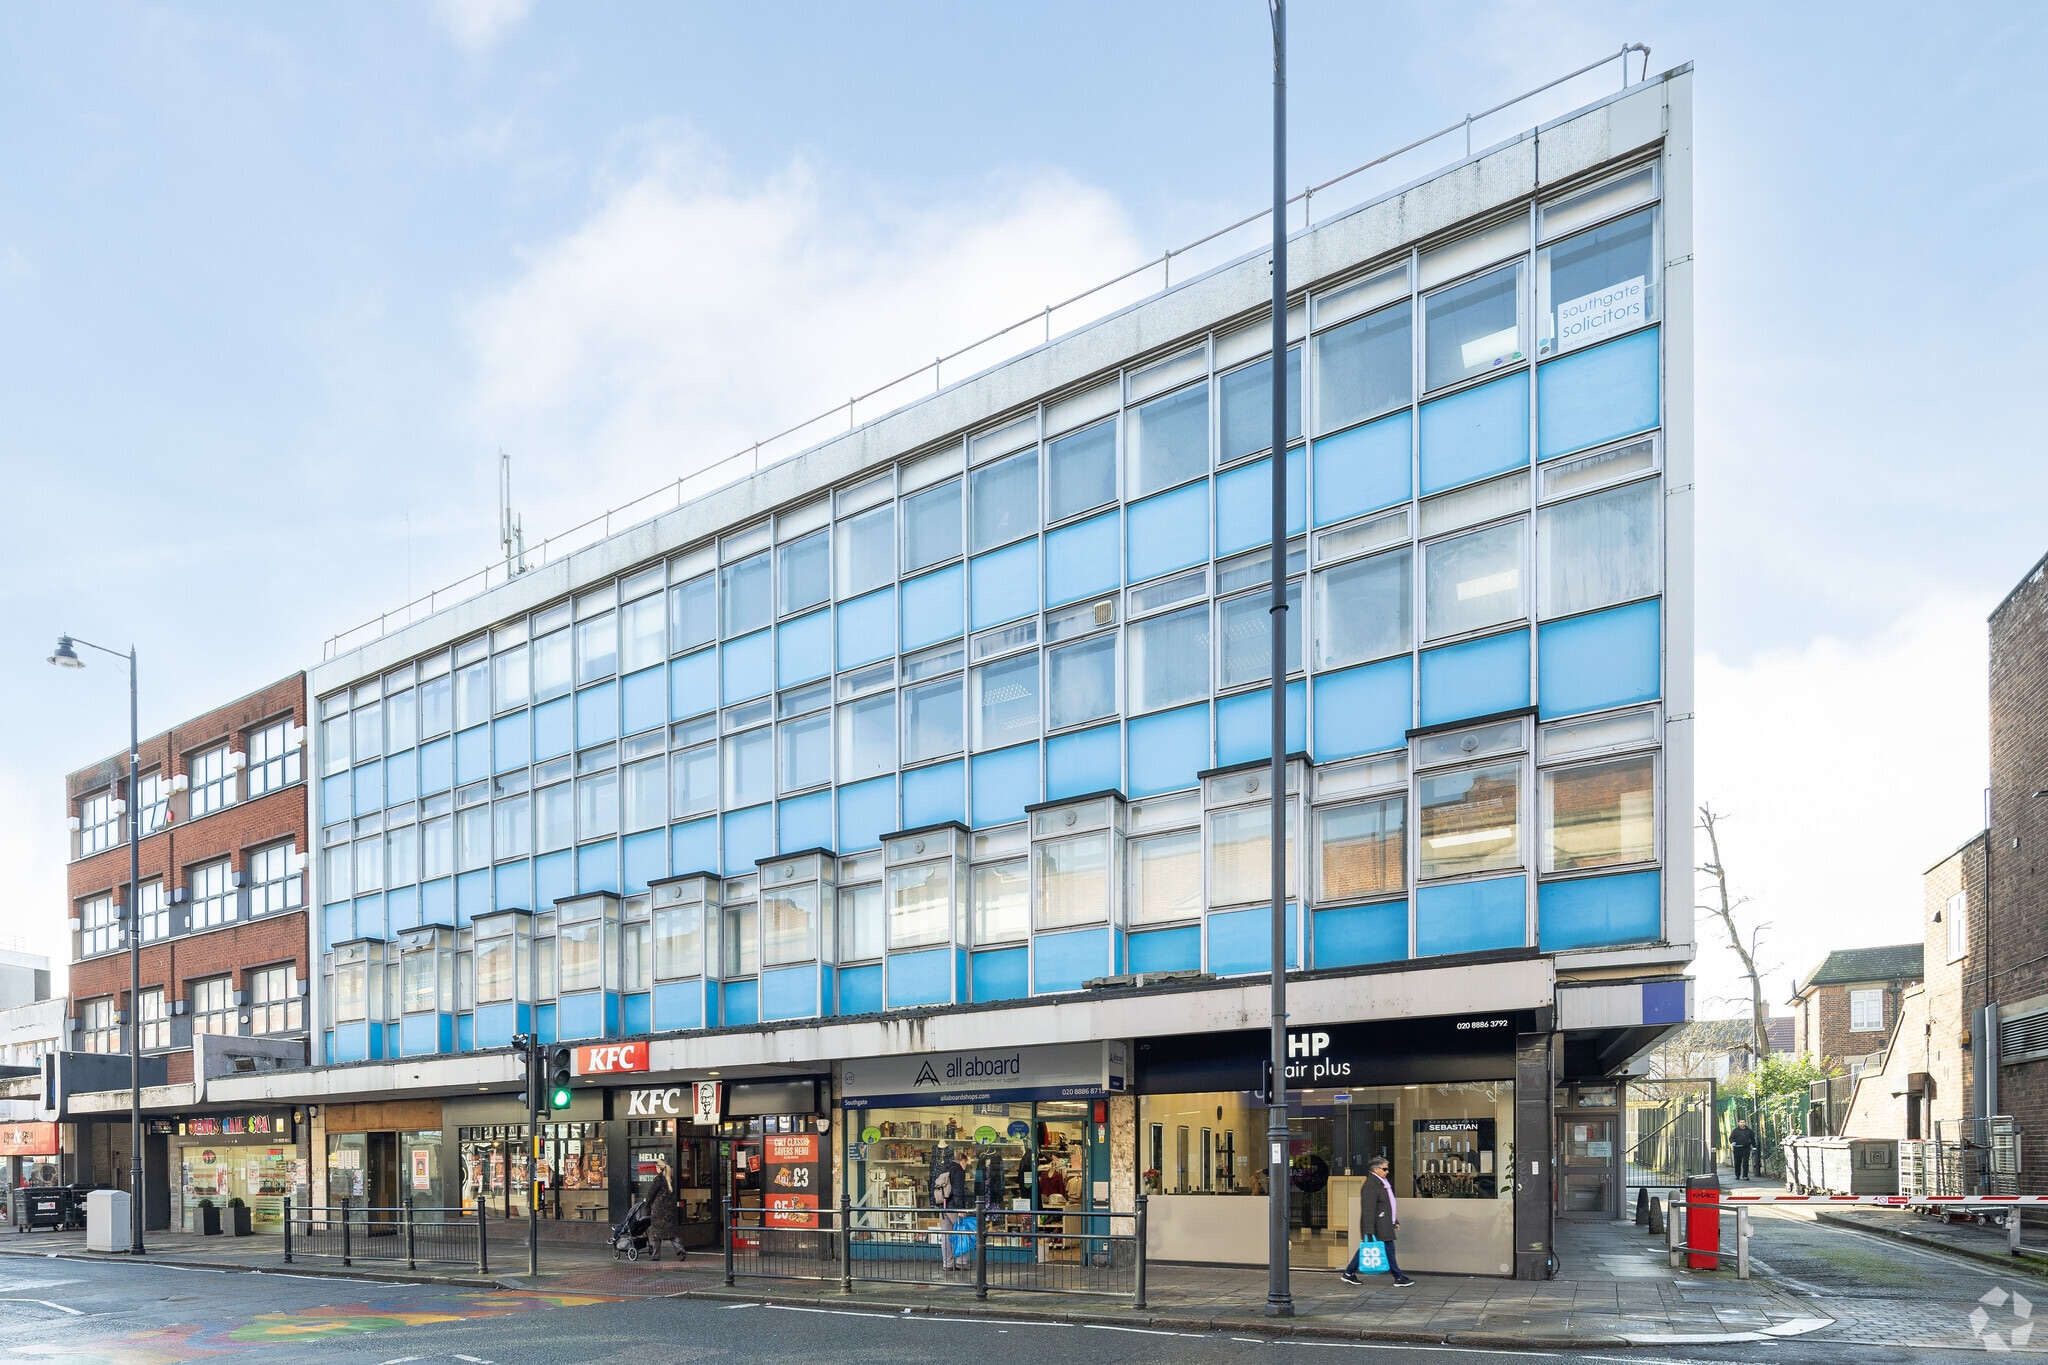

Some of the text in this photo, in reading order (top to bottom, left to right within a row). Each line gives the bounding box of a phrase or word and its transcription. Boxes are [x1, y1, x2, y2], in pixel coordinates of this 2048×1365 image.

[1562, 285, 1639, 319] southgate
[1563, 302, 1640, 338] solicitors
[1456, 1019, 1508, 1030] 020 8886 3792
[1288, 1032, 1330, 1058] HP
[588, 1045, 634, 1071] KFC
[946, 1053, 1020, 1078] all aboard
[1284, 1056, 1351, 1081] air plus
[940, 1093, 990, 1102] allaboardshops.com
[1062, 1088, 1073, 1096] 020
[627, 1088, 681, 1116] KFC
[844, 1099, 868, 1107] Southgate
[248, 1114, 271, 1133] SPA
[1428, 1123, 1478, 1131] SEBASTIAN
[638, 1153, 665, 1162] HELLO
[774, 1146, 809, 1156] SAVERS MENU
[793, 1167, 809, 1188] £3
[774, 1200, 789, 1219] £5
